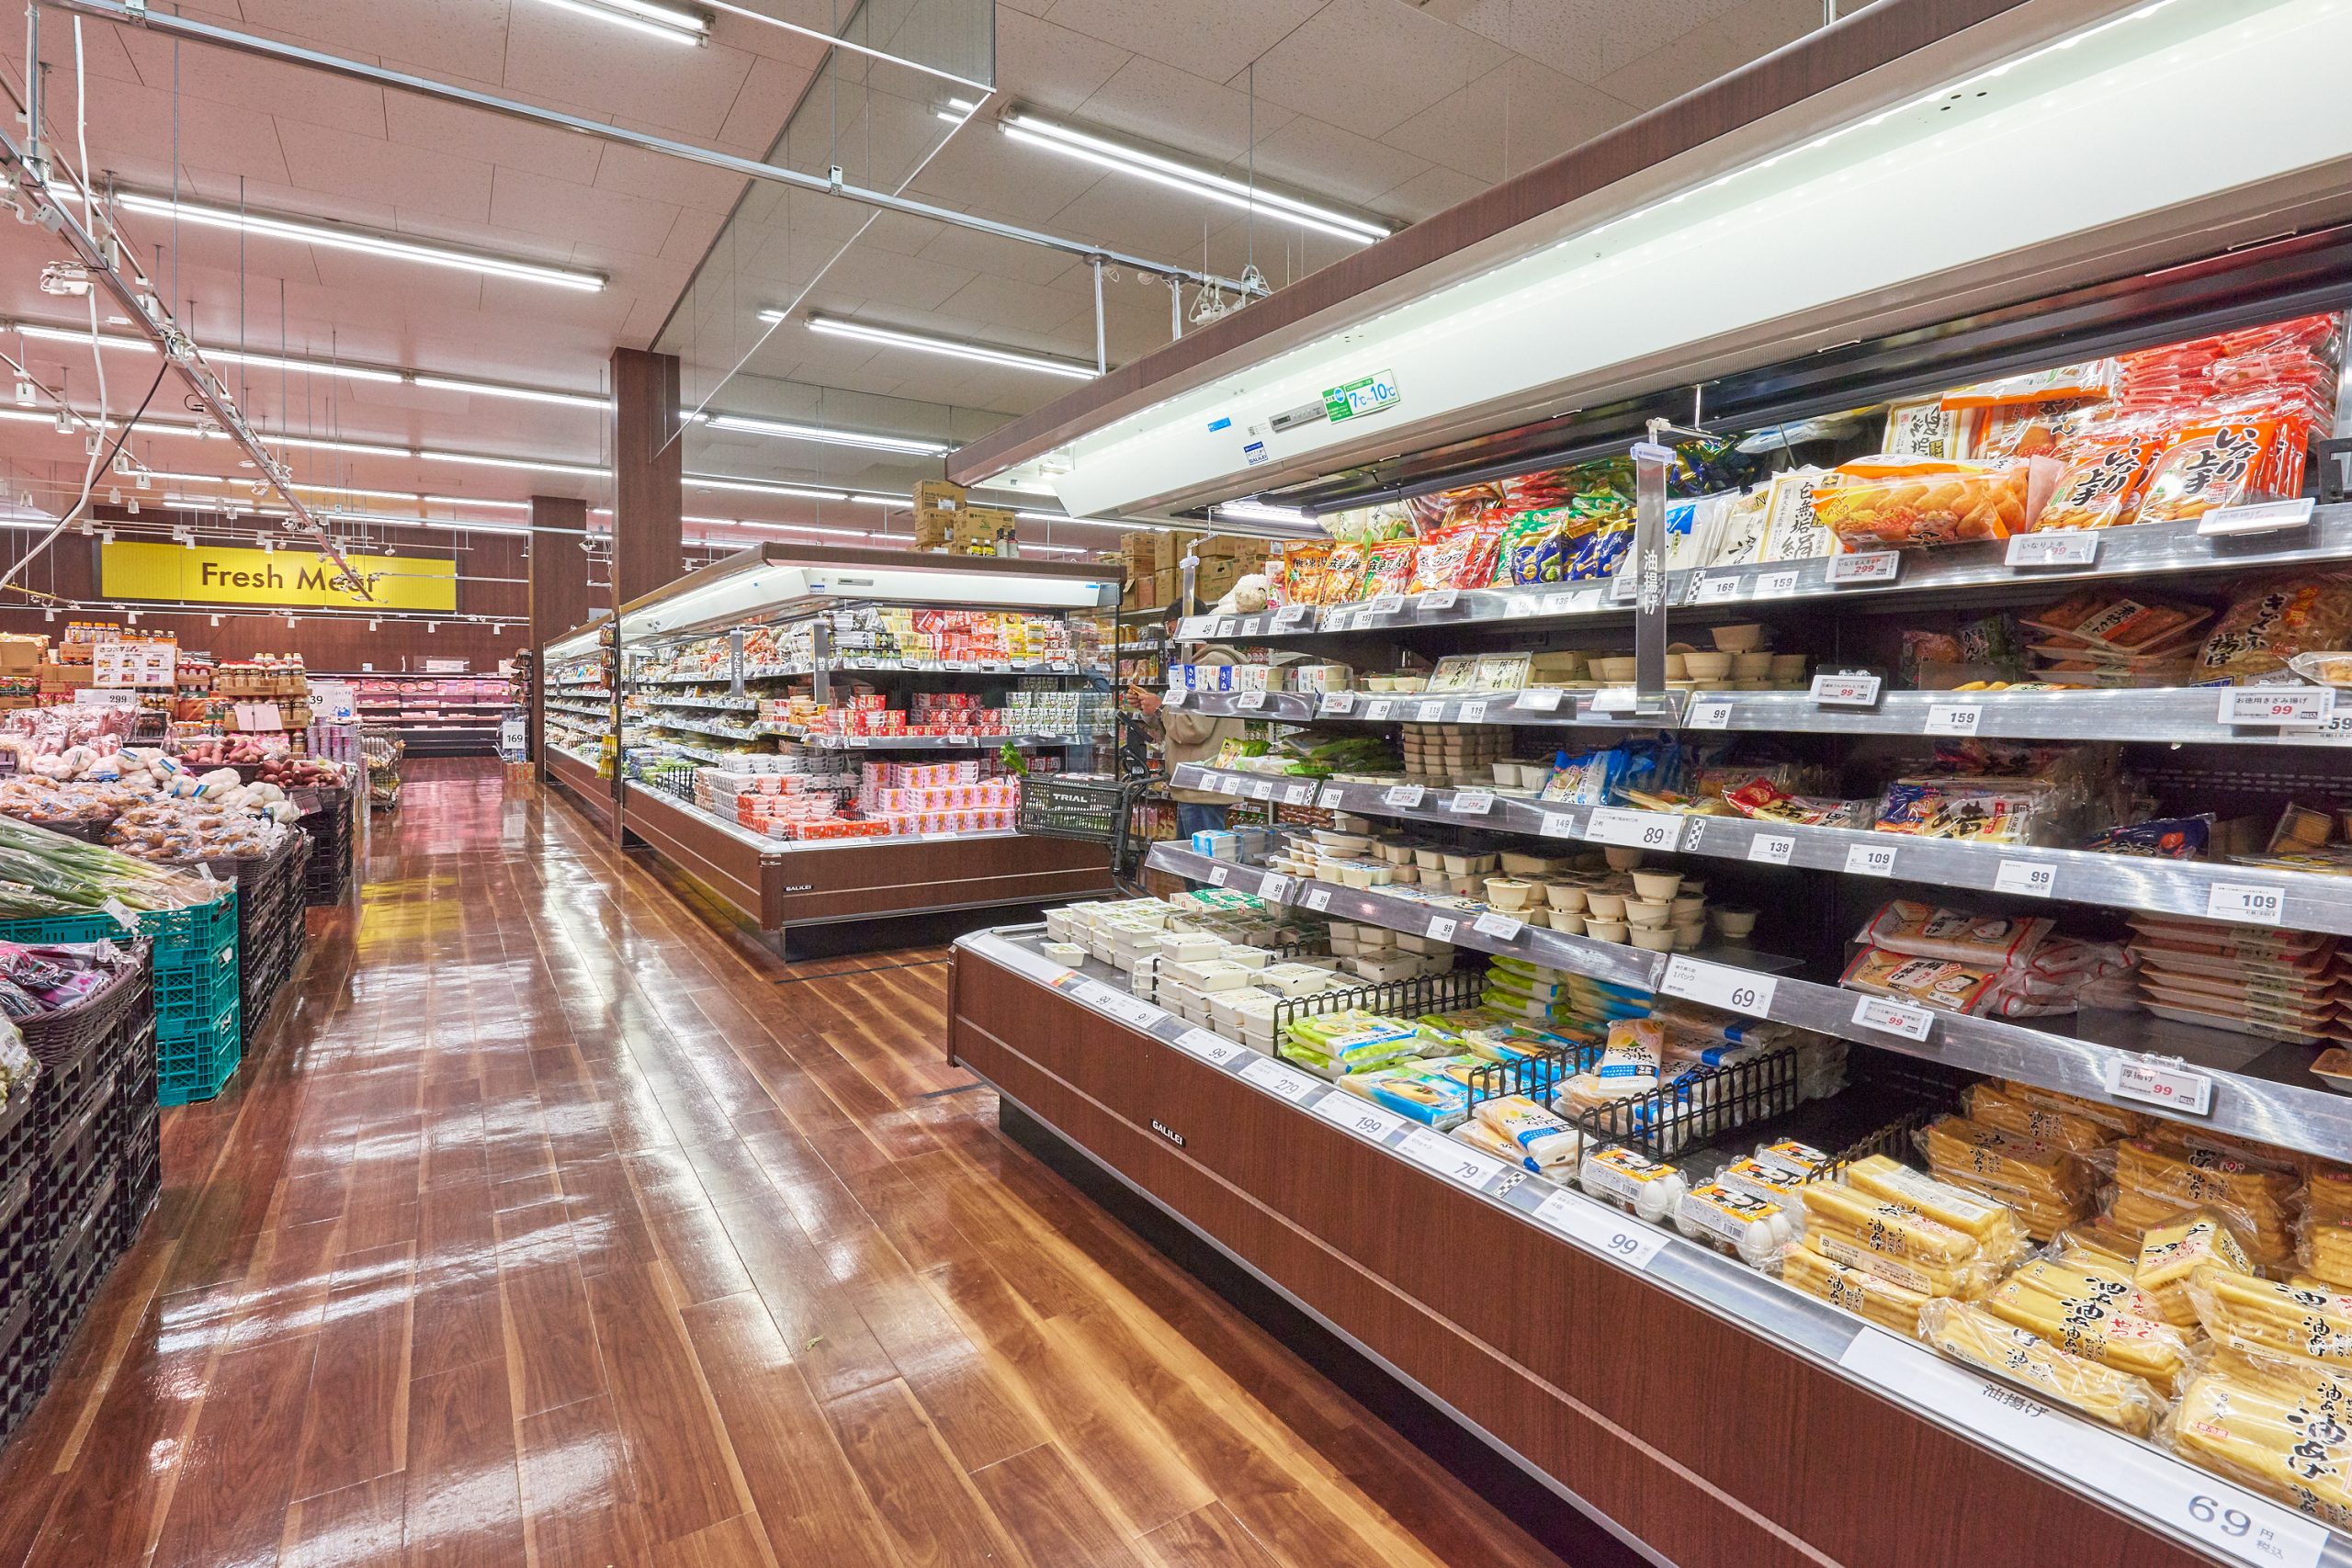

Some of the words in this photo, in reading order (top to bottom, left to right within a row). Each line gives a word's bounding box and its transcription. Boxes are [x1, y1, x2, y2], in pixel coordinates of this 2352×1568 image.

[2215, 426, 2260, 482] いなり
[2102, 445, 2141, 495] いなり
[2183, 448, 2219, 495] 上手
[2071, 468, 2105, 506] 上手
[2021, 539, 2064, 550] いなり上手
[202, 562, 283, 589] Fresh
[1854, 565, 1874, 574] 299
[1644, 549, 1658, 615] 油揚げ
[1716, 582, 1735, 592] 169
[1773, 578, 1792, 588] 159
[1203, 624, 1213, 635] 49
[817, 656, 826, 671] 納豆
[109, 694, 127, 704] 299
[2236, 696, 2309, 705] お徳用きざみ揚げ
[1713, 709, 1726, 718] 99
[2271, 705, 2293, 715] 99
[1950, 712, 1975, 724] 159
[506, 734, 523, 743] 169
[1053, 793, 1088, 804] TRIAL
[1555, 818, 1570, 829] 149
[1643, 827, 1664, 844] 89
[1770, 841, 1790, 853] 139
[1868, 852, 1890, 864] 109
[2030, 871, 2050, 884] 99
[2243, 894, 2278, 908] 109
[1443, 924, 1453, 932] 99
[1731, 987, 1756, 1008] 69
[1888, 1016, 1904, 1027] 99
[1208, 1047, 1227, 1058] 99
[1273, 1078, 1300, 1095] 279
[2153, 1084, 2173, 1096] 99
[1354, 1116, 1383, 1134] 199
[1152, 1120, 1183, 1145] GALILEI
[1453, 1161, 1479, 1179] 79
[1868, 1218, 1885, 1251] 油あげ
[1608, 1234, 1638, 1255] 99
[1983, 1383, 2050, 1418] 油揚げ
[2188, 1495, 2252, 1538] 69
[2259, 1528, 2275, 1541] 円
[2256, 1540, 2284, 1560] 税込
